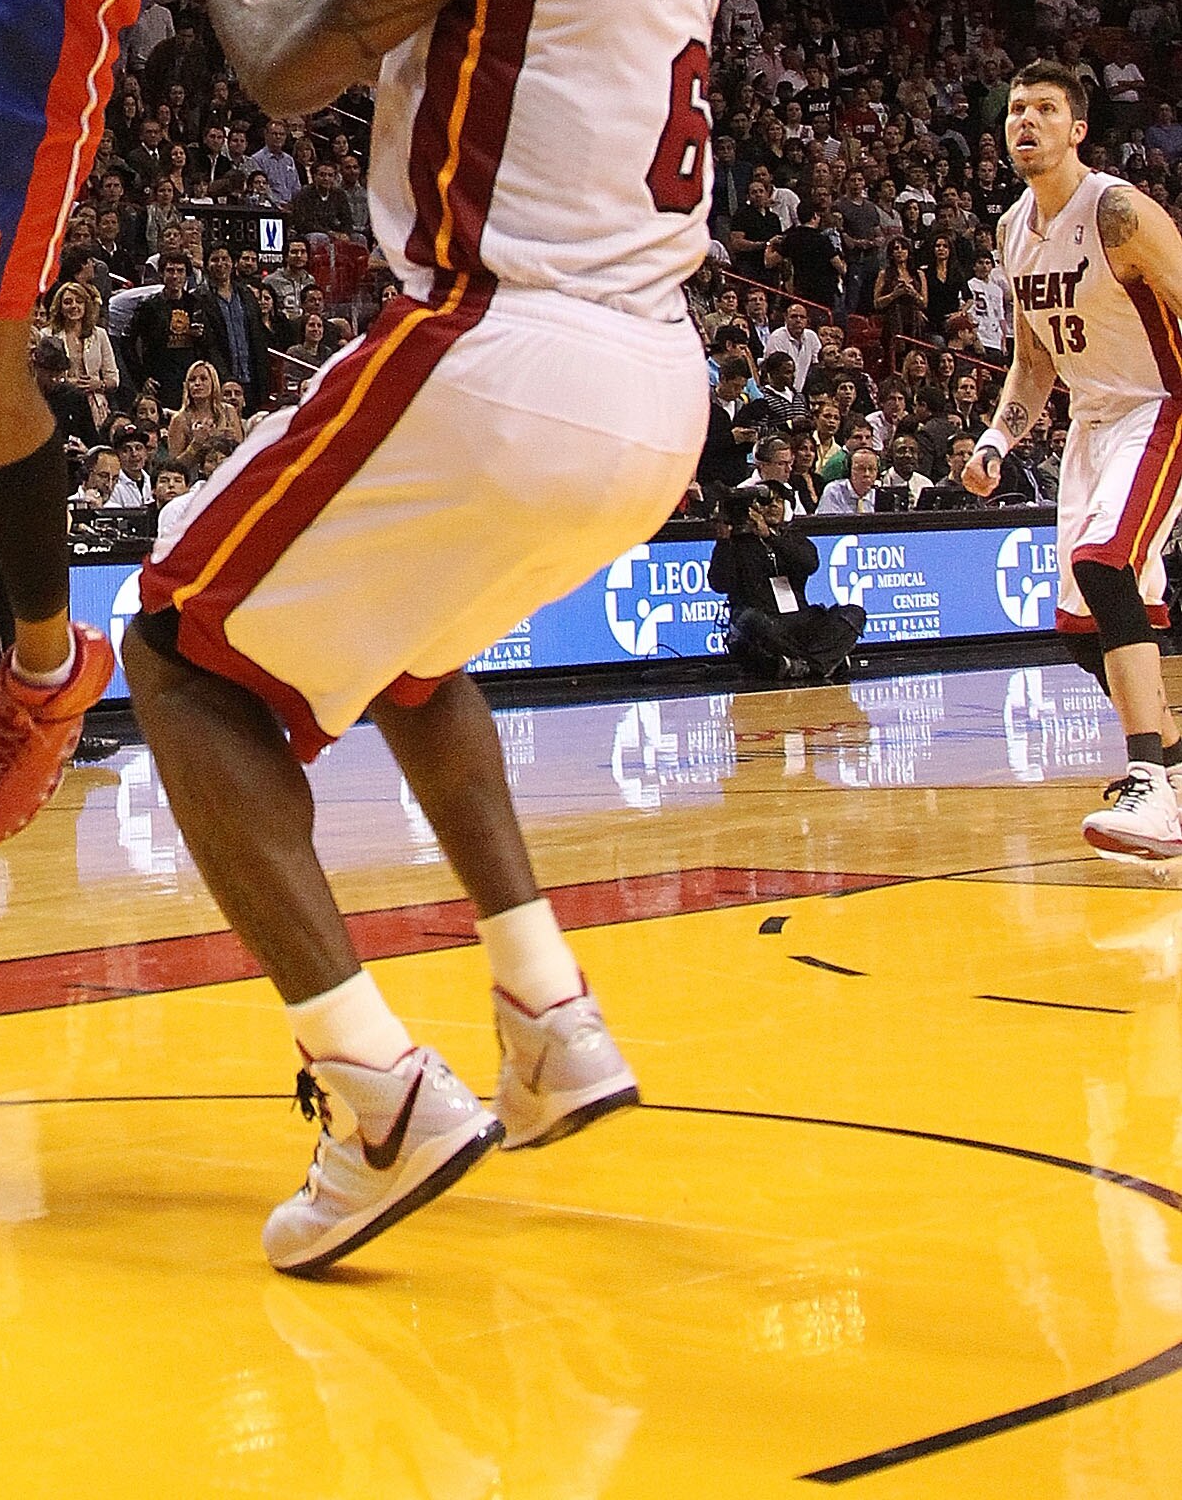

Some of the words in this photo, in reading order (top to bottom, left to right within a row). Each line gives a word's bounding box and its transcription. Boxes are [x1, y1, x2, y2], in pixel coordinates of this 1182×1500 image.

[809, 101, 831, 113] HEAT
[644, 37, 711, 215] 6
[1013, 256, 1090, 312] HEAT
[1048, 315, 1087, 355] 13
[856, 546, 906, 571] LEON
[877, 572, 927, 589] MEDICAL
[892, 592, 940, 610] CENTERS
[902, 617, 940, 630] PLANS
[484, 644, 531, 660] PLANS
